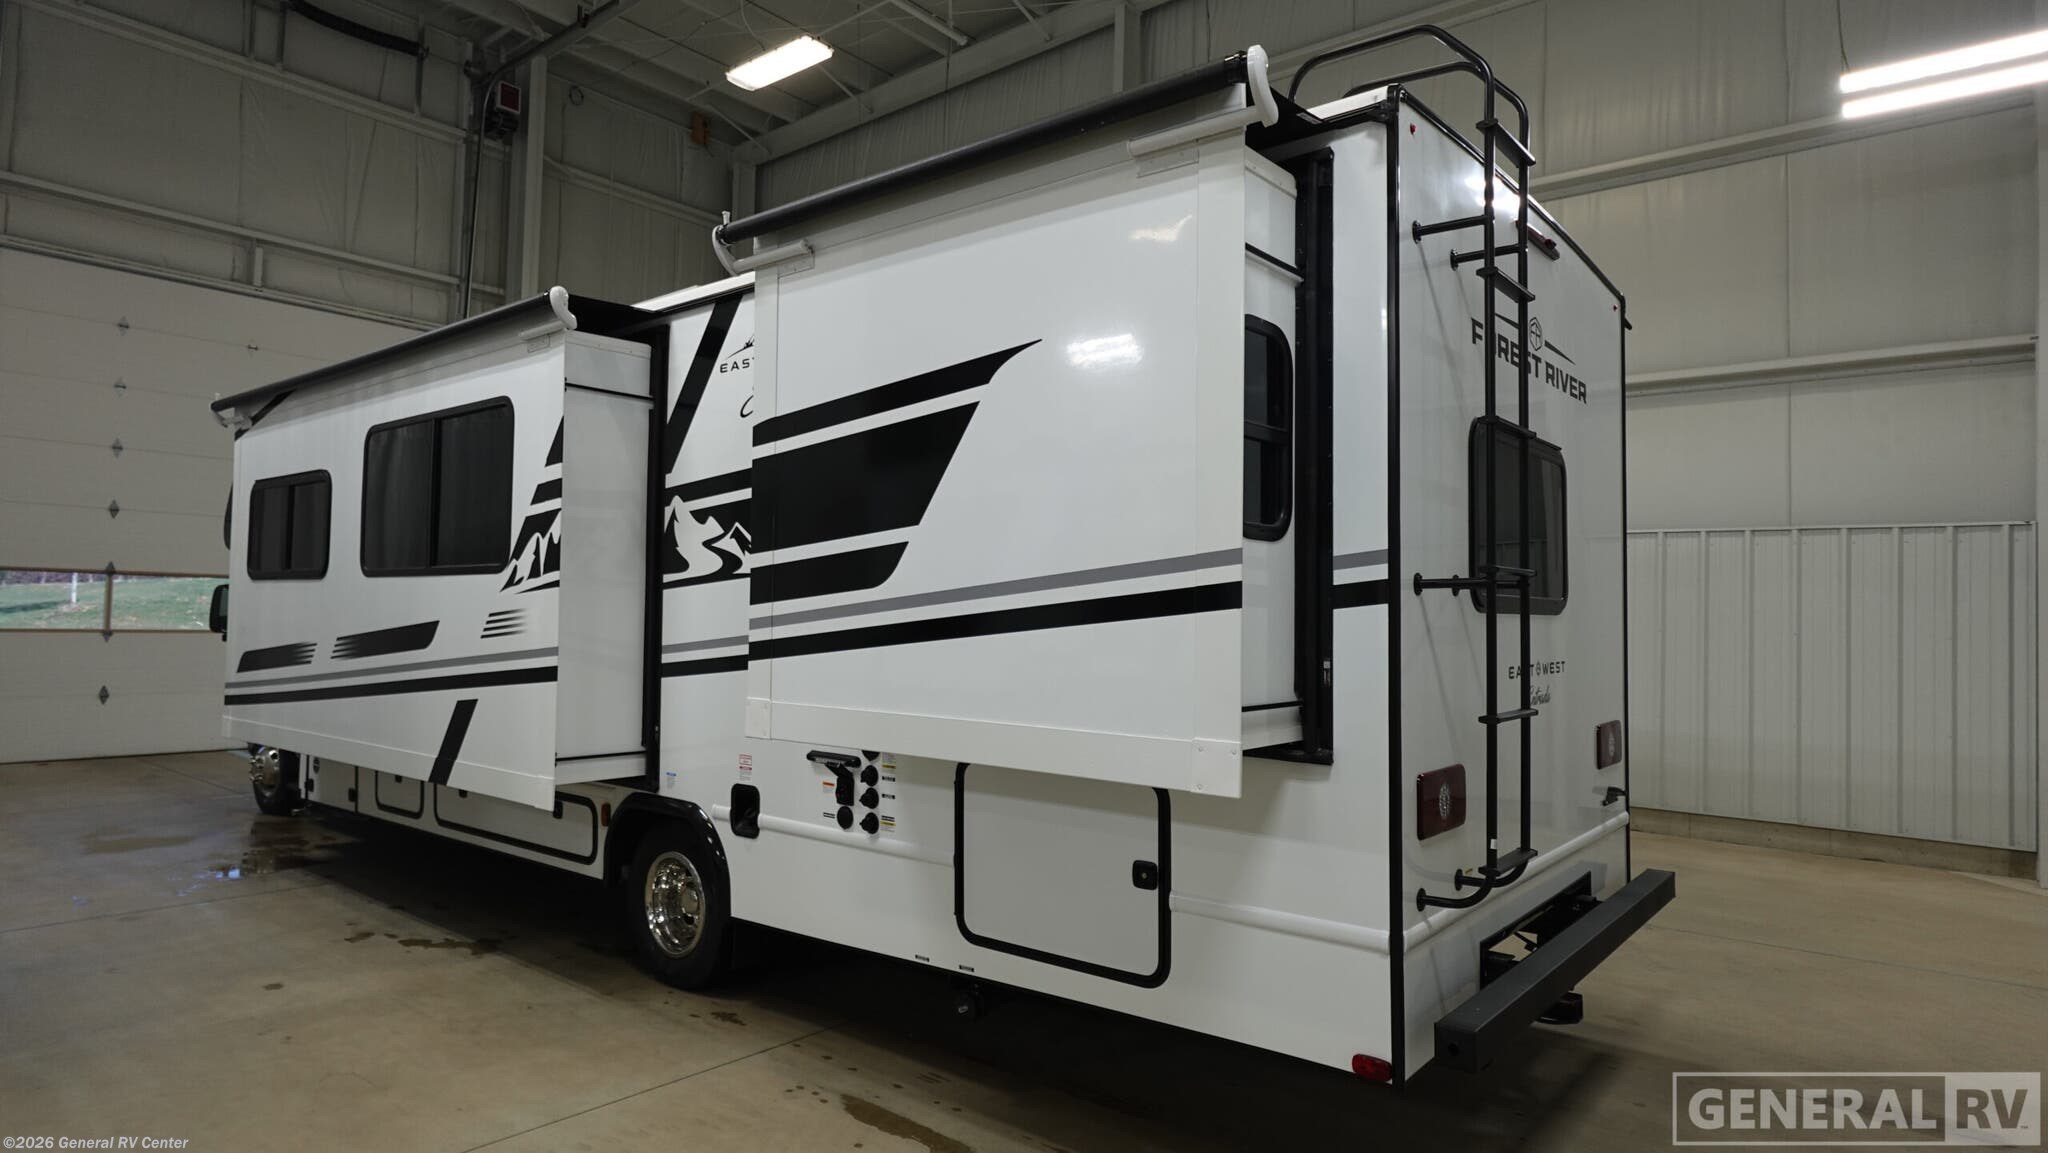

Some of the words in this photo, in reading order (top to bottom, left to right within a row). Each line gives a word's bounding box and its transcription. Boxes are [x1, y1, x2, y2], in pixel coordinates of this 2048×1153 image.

[720, 356, 754, 373] EAS
[1471, 317, 1542, 378] FRET
[1545, 361, 1587, 404] RIVER
[1508, 665, 1534, 679] EAT
[1542, 661, 1565, 675] WEST
